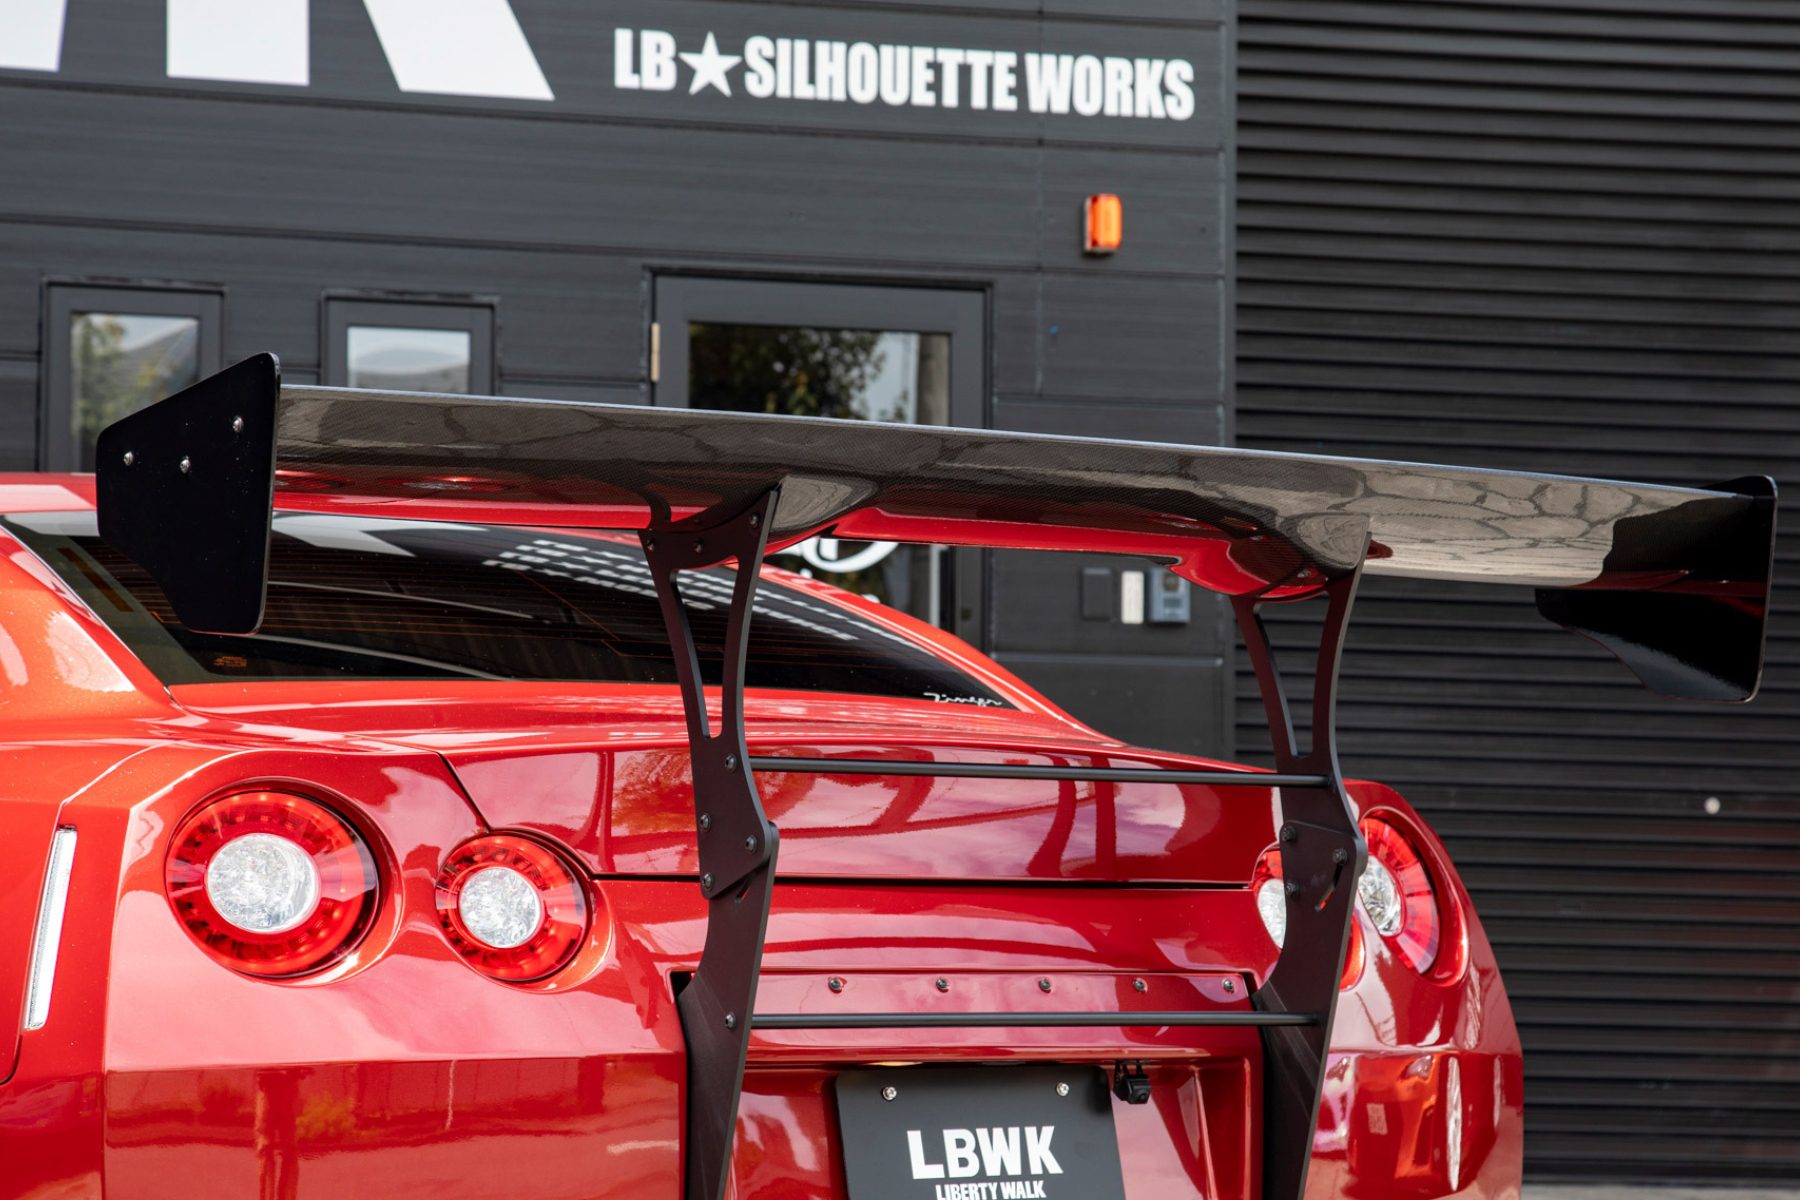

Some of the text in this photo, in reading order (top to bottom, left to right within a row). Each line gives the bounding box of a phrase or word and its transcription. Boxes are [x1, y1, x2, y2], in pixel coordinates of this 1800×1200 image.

[744, 35, 1018, 110] SILHOUETTE
[1024, 53, 1195, 120] WORKS
[906, 1125, 1064, 1180] LBWK
[935, 1180, 1047, 1200] LIBERTY WALK
